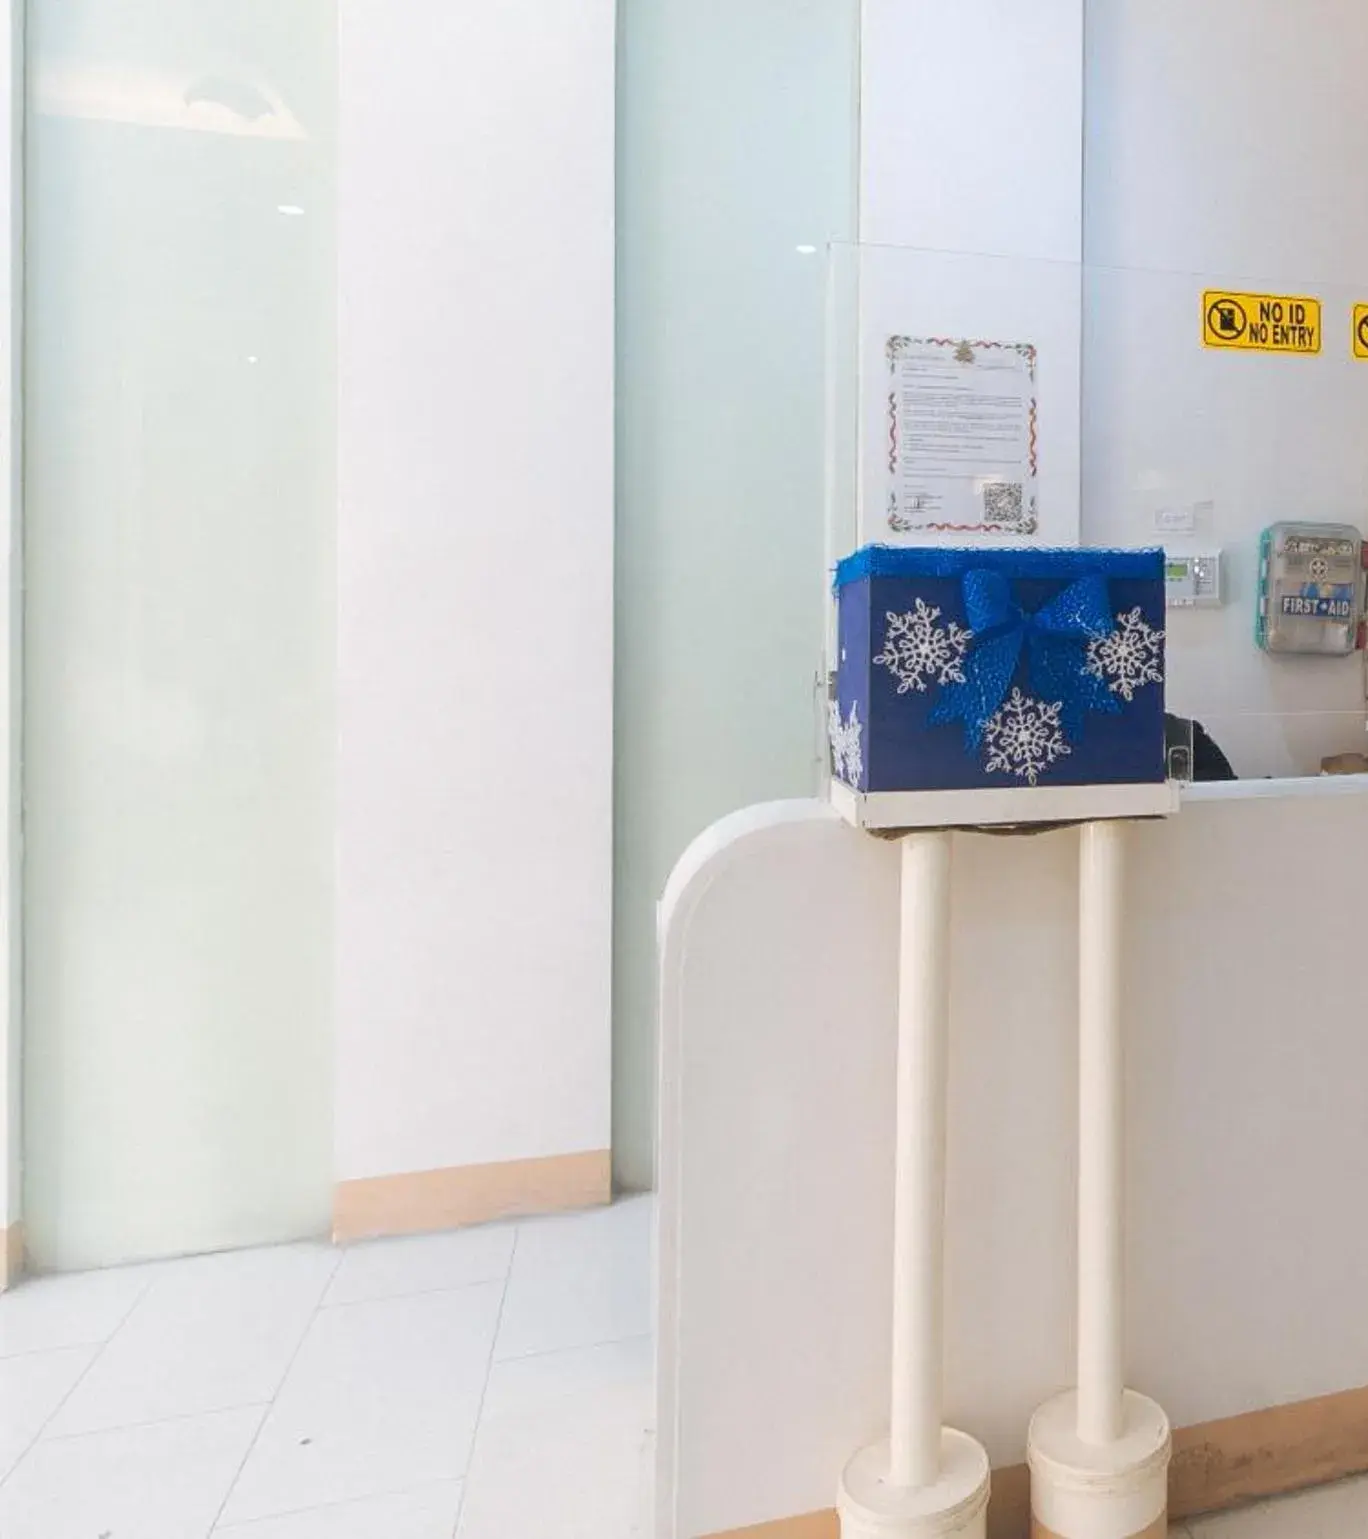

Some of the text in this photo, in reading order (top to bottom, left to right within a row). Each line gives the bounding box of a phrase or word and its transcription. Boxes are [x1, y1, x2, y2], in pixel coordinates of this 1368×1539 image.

[1259, 301, 1305, 325] NO ID
[1249, 322, 1314, 347] NO ENTRY
[1282, 597, 1350, 616] FIRST AID
